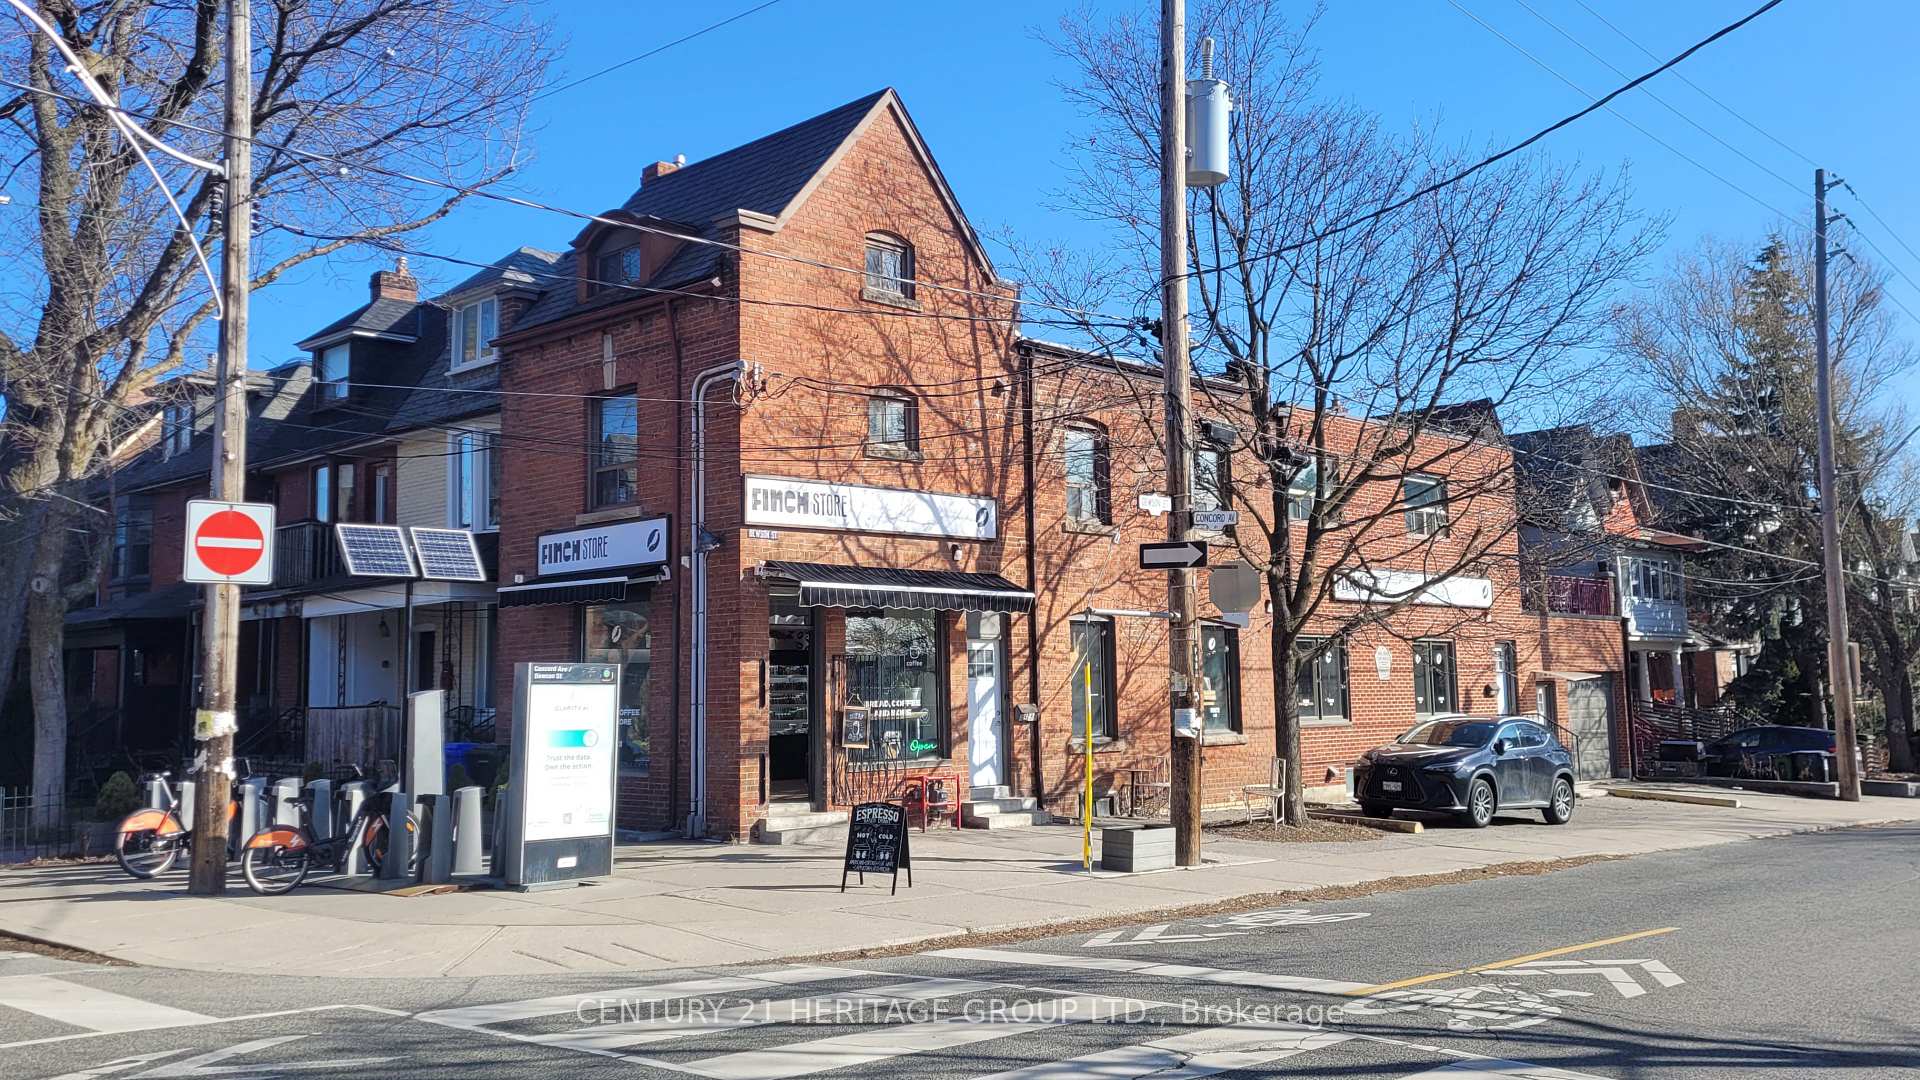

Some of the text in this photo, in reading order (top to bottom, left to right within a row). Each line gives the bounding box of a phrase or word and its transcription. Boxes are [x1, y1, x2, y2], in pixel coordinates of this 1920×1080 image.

[752, 488, 848, 518] FINCH STORE
[1195, 512, 1225, 523] CONCORD
[541, 535, 608, 565] FINCH STORE
[910, 740, 938, 754] Open
[855, 807, 899, 822] ESPRESSO
